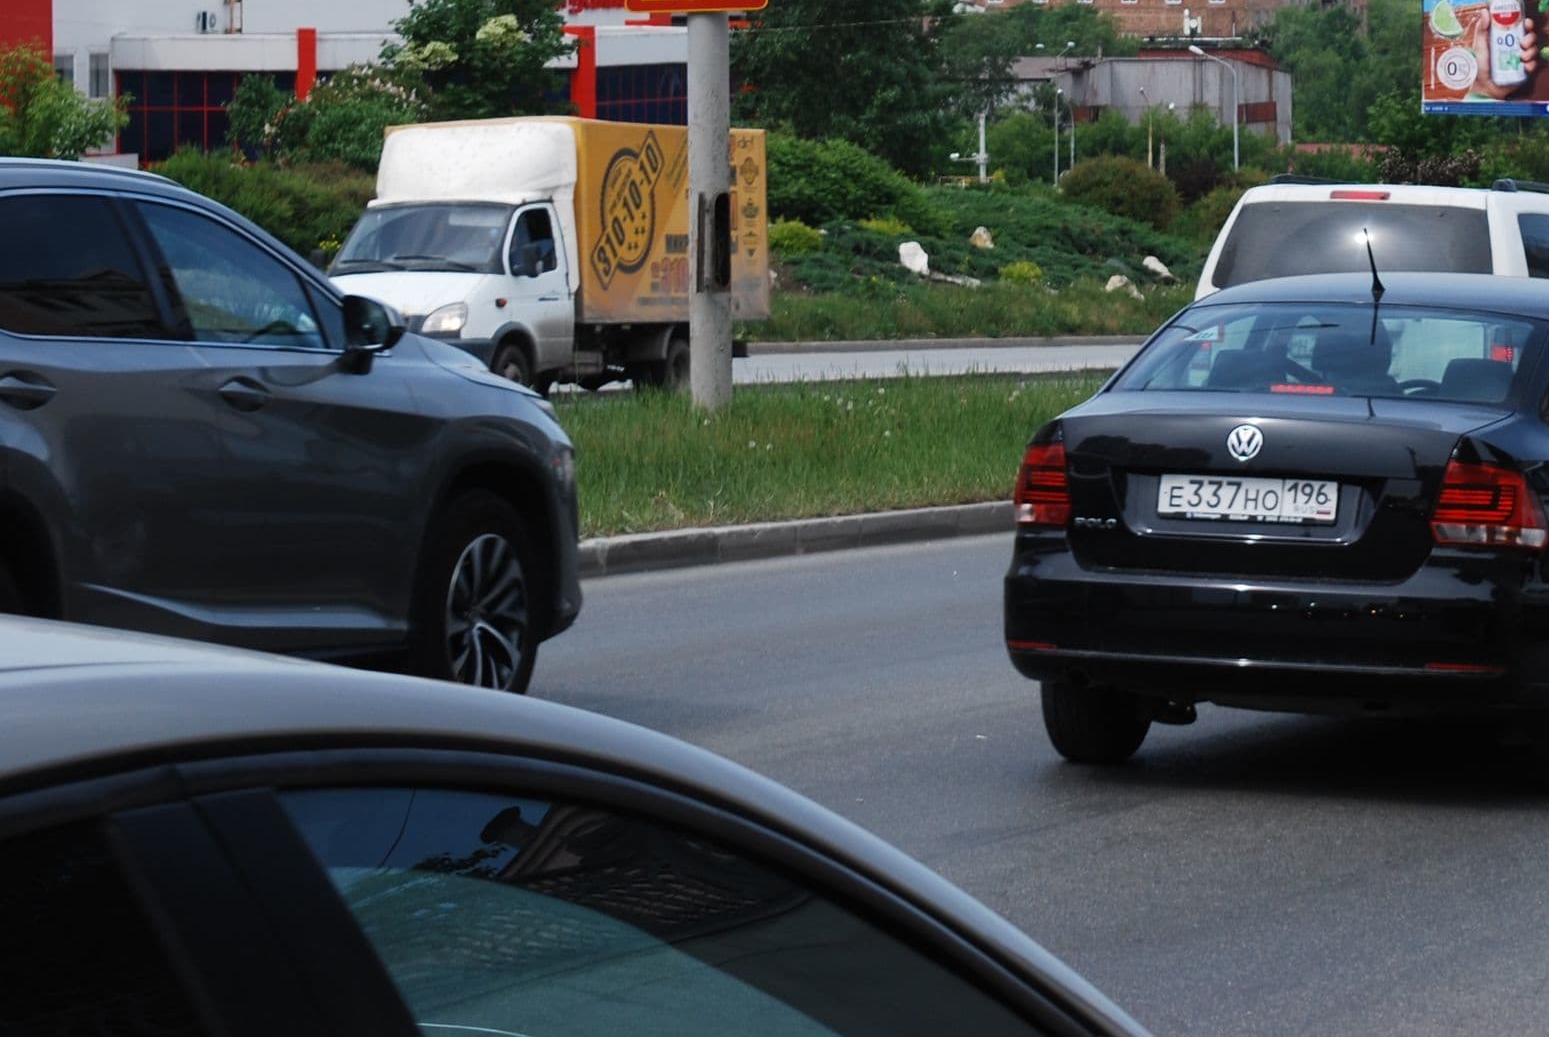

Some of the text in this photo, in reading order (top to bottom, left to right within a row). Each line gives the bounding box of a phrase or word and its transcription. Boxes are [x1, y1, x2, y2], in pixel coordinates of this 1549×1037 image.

[596, 141, 661, 278] 310-10-10
[1169, 479, 1329, 511] Е337НО 196
[1074, 516, 1117, 529] POLO
